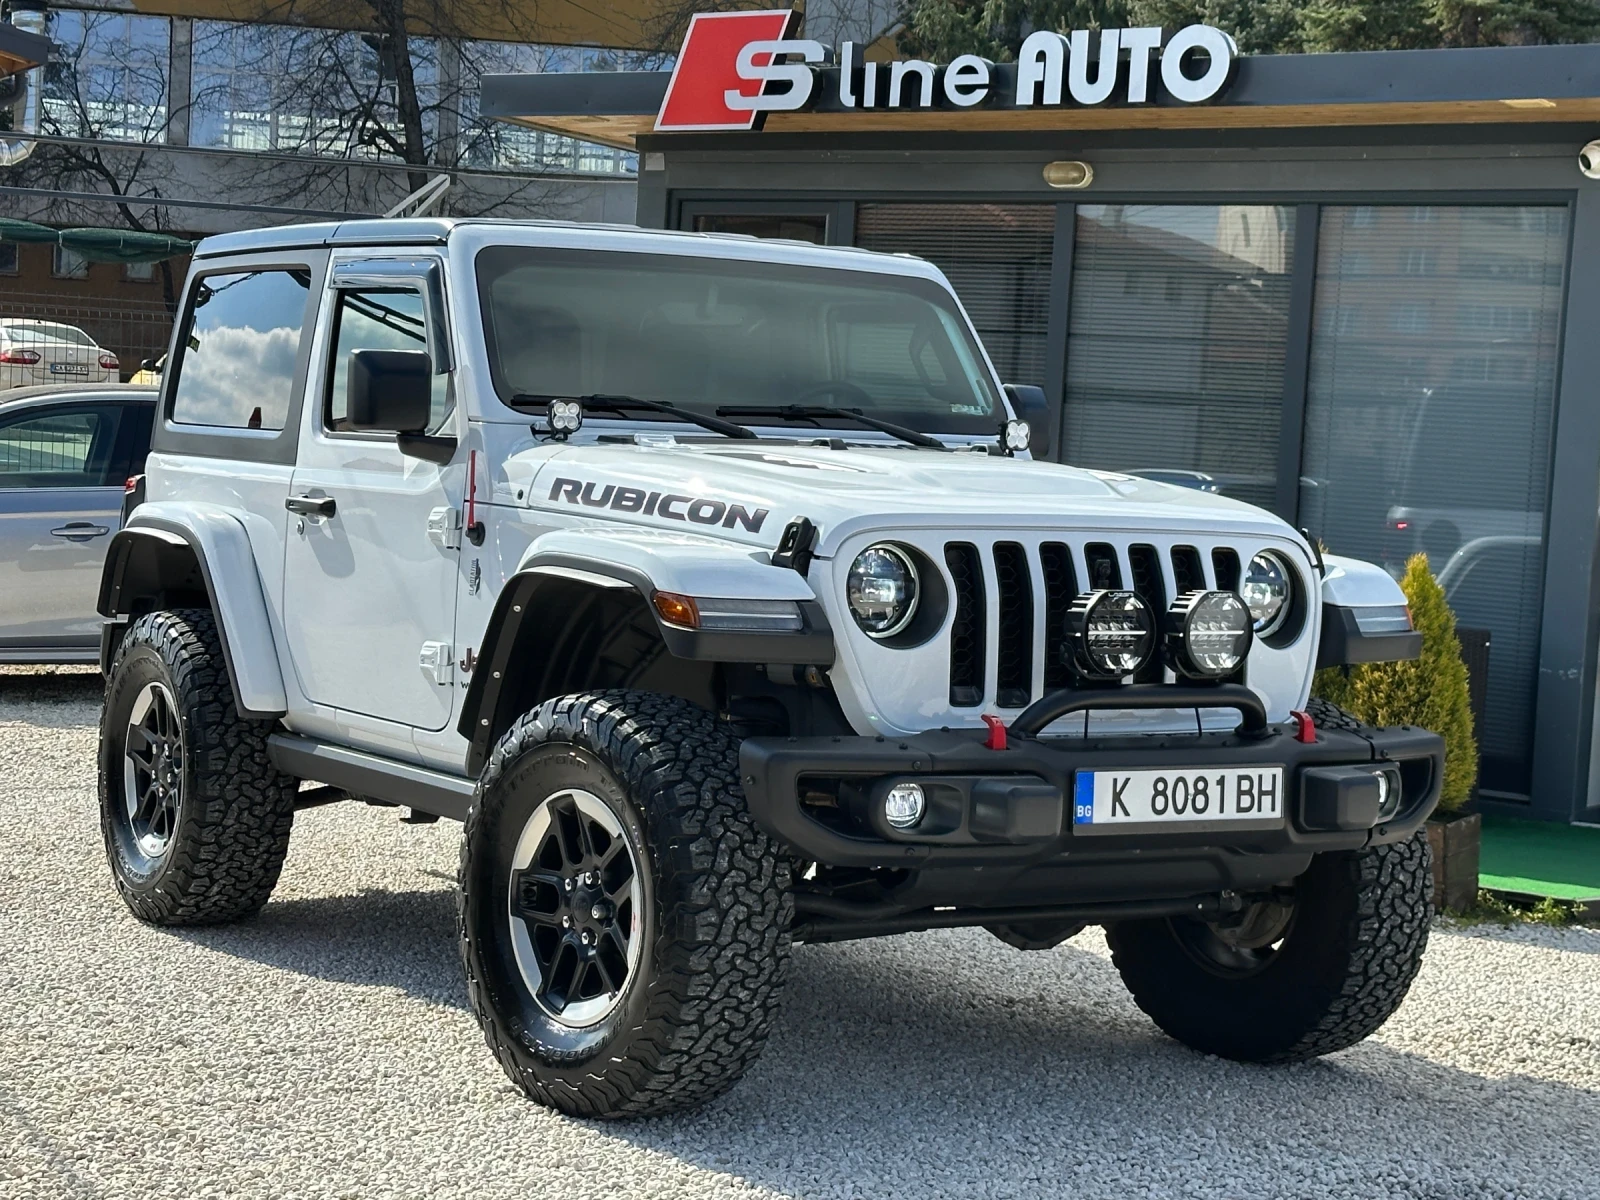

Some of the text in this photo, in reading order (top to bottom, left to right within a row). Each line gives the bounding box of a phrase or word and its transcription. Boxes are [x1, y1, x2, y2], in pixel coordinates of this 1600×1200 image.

[724, 24, 1231, 111] S line AUTO
[548, 477, 770, 533] RUBICON
[1077, 805, 1092, 817] BG
[1111, 777, 1131, 817] K
